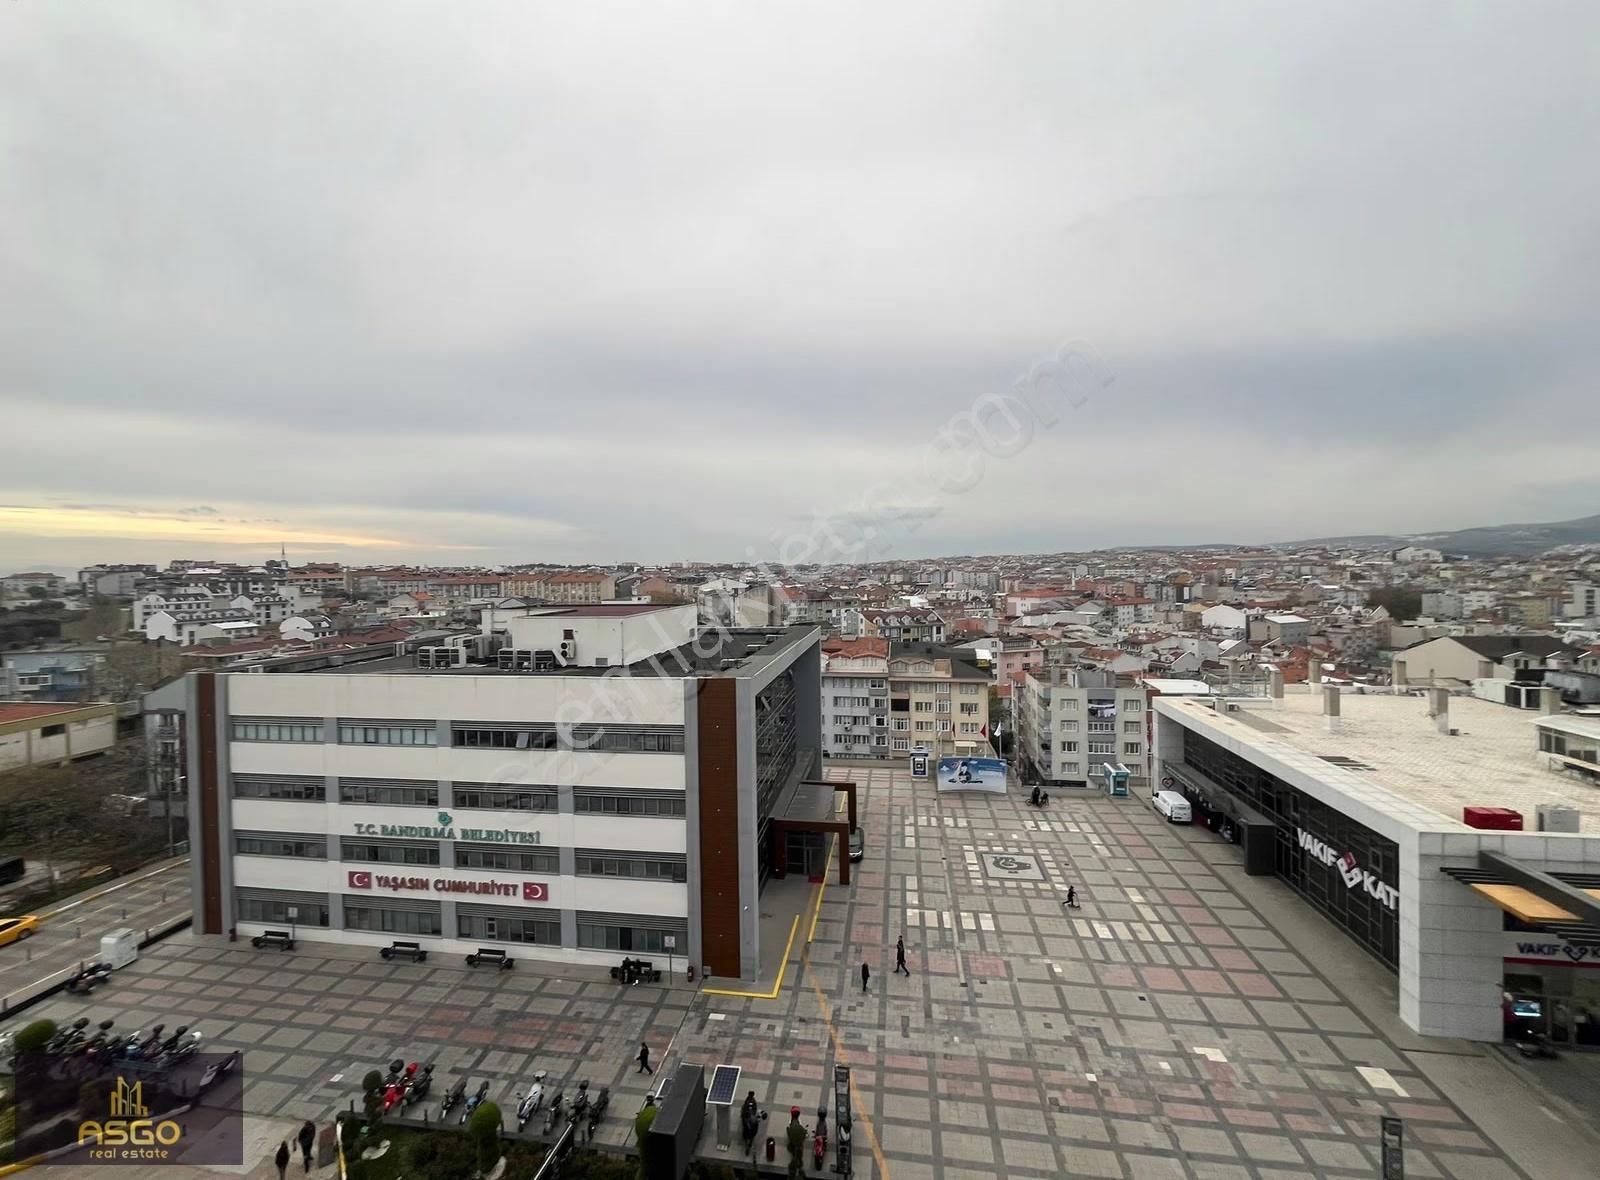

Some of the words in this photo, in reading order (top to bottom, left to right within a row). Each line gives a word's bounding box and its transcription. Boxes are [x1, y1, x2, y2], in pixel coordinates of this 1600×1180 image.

[354, 823, 377, 835] T.C.
[380, 825, 456, 840] BANDIRMA
[460, 828, 541, 844] BELEDİYESİ
[1297, 828, 1339, 867] VAKIF
[375, 875, 429, 891] YAŞASIN
[433, 878, 518, 896] CUMHURİYET
[1516, 943, 1560, 956] VAKIF
